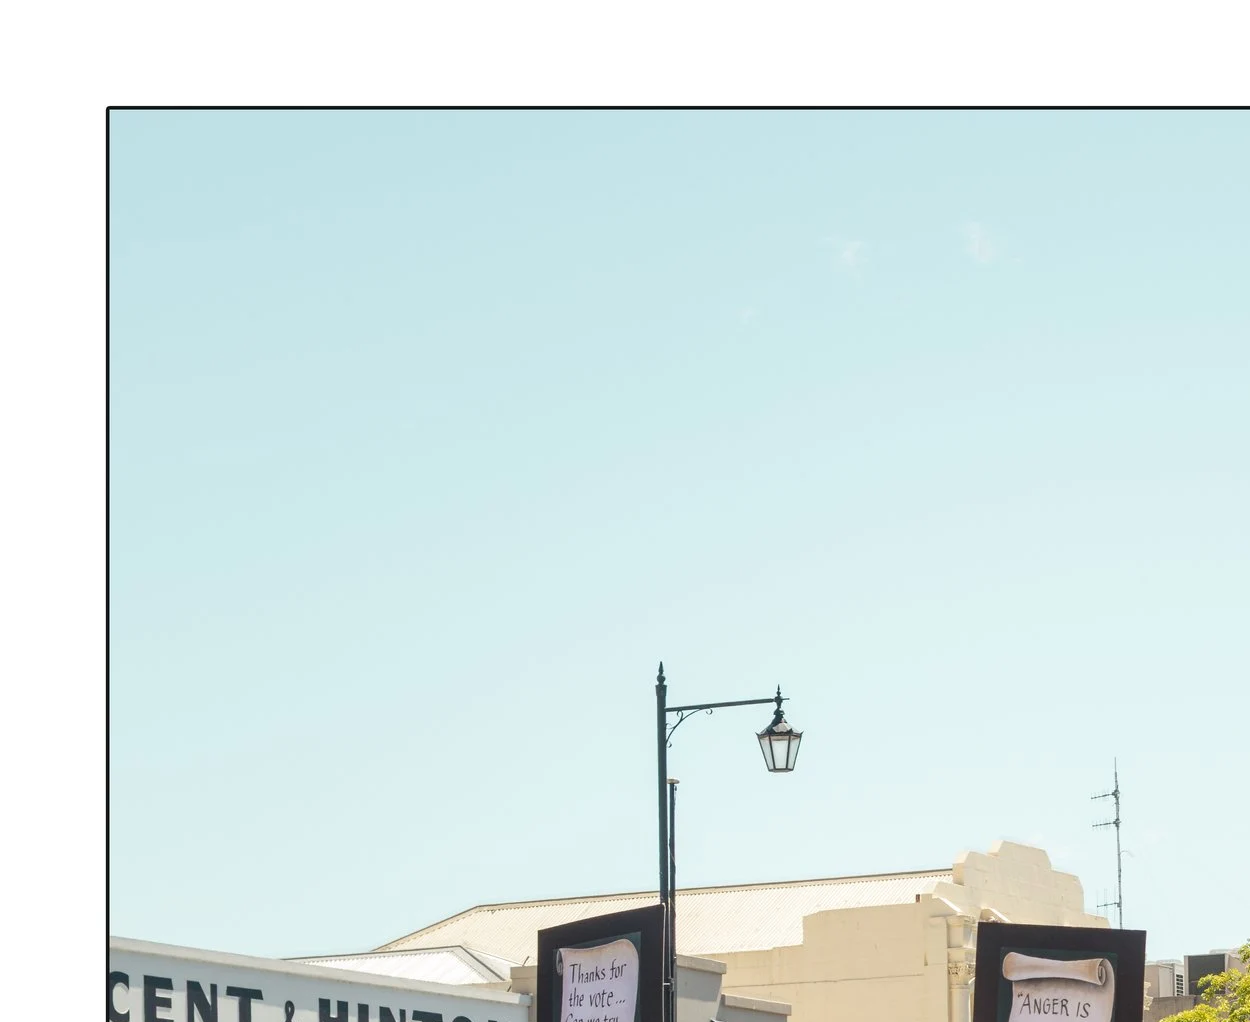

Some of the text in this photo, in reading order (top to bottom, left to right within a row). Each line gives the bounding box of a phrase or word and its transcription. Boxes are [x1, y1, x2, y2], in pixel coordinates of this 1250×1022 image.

[569, 958, 627, 985] Thanks for
[568, 987, 585, 1008] the
[1076, 1002, 1091, 1019] IS
